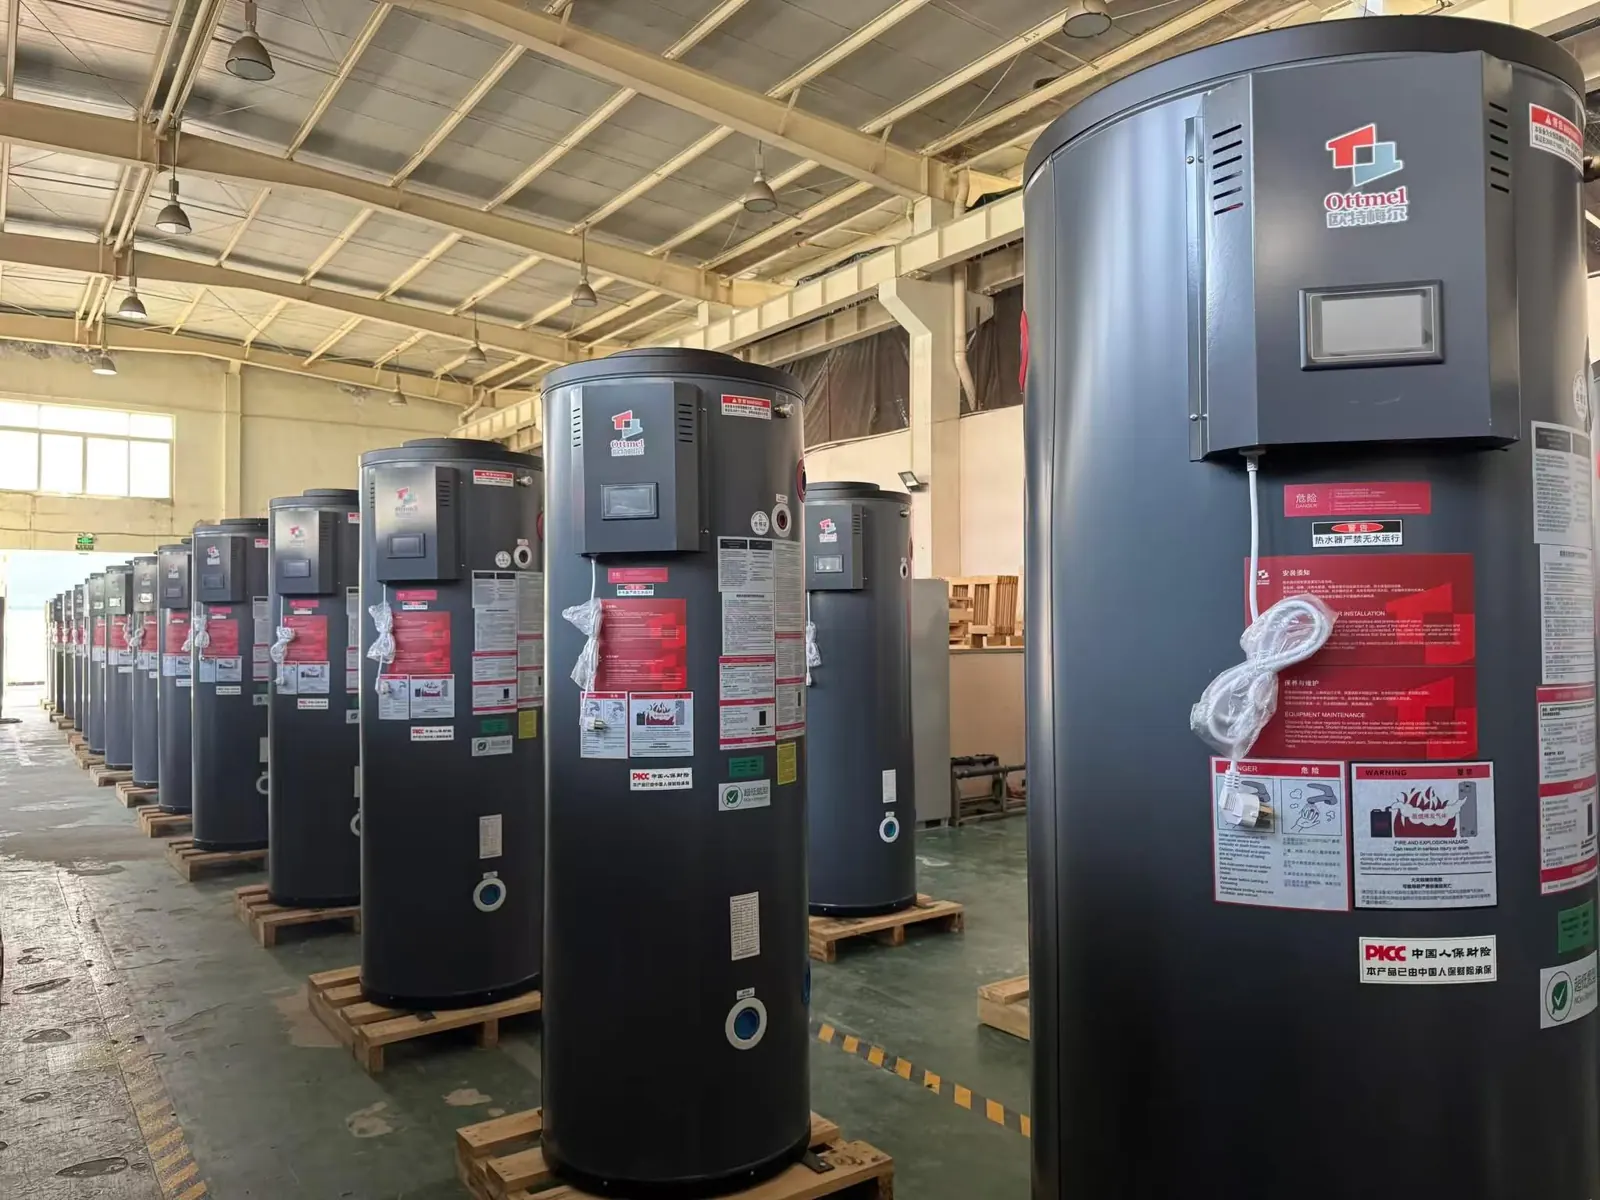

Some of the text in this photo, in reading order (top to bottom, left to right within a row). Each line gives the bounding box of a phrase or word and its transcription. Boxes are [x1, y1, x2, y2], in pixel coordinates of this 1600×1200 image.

[1324, 186, 1408, 211] Ottmel
[1326, 207, 1408, 228] 欧特梅尔
[610, 438, 645, 449] Ottmel
[1295, 493, 1318, 504] 危险
[1347, 524, 1369, 533] 警告
[1314, 535, 1401, 545] 热水器严禁无水运行
[1282, 569, 1311, 577] 安装须知
[1284, 679, 1320, 687] 保养与维护
[1226, 764, 1258, 773] DNGER
[1300, 766, 1320, 775] 危险
[632, 772, 650, 780] PICC
[1364, 944, 1492, 962] PICC 中国人保财险
[1366, 965, 1493, 977] 本产品已由中国人保财险承保
